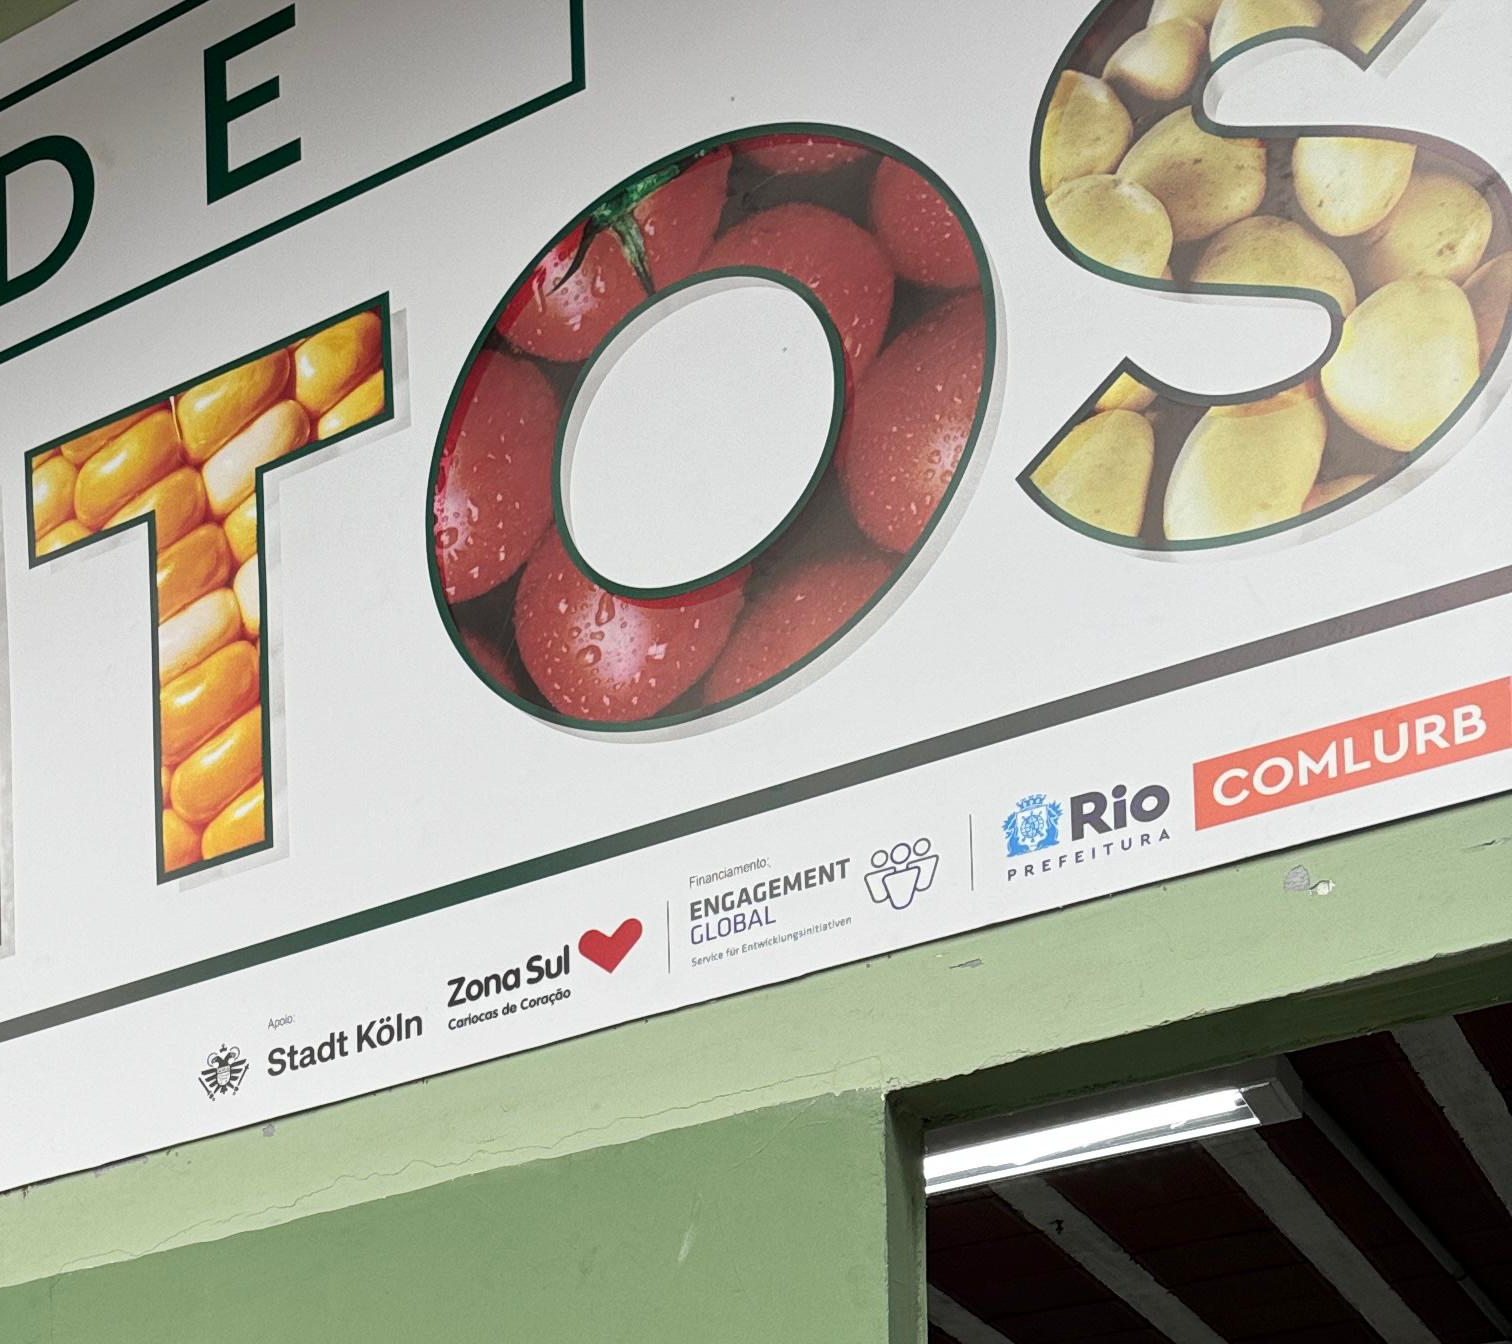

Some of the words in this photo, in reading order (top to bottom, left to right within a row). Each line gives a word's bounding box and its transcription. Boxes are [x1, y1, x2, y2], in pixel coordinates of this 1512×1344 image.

[1212, 703, 1487, 807] COMLURB
[1070, 784, 1170, 841] Rio
[689, 856, 771, 889] Financiamento:
[1007, 828, 1170, 881] PREFEITURA
[690, 857, 850, 921] ENGAGEMENT
[690, 905, 776, 945] GLOBAL
[691, 950, 724, 967] Service
[726, 946, 740, 958] für
[742, 915, 852, 953] Entwicklungsinitiativen
[447, 967, 521, 1008] Zona
[526, 945, 570, 985] Sul
[448, 1007, 498, 1030] Cariocas
[501, 1001, 518, 1015] de
[520, 987, 571, 1010] Coração
[267, 1030, 349, 1077] Stadt
[356, 1013, 423, 1053] Köln
